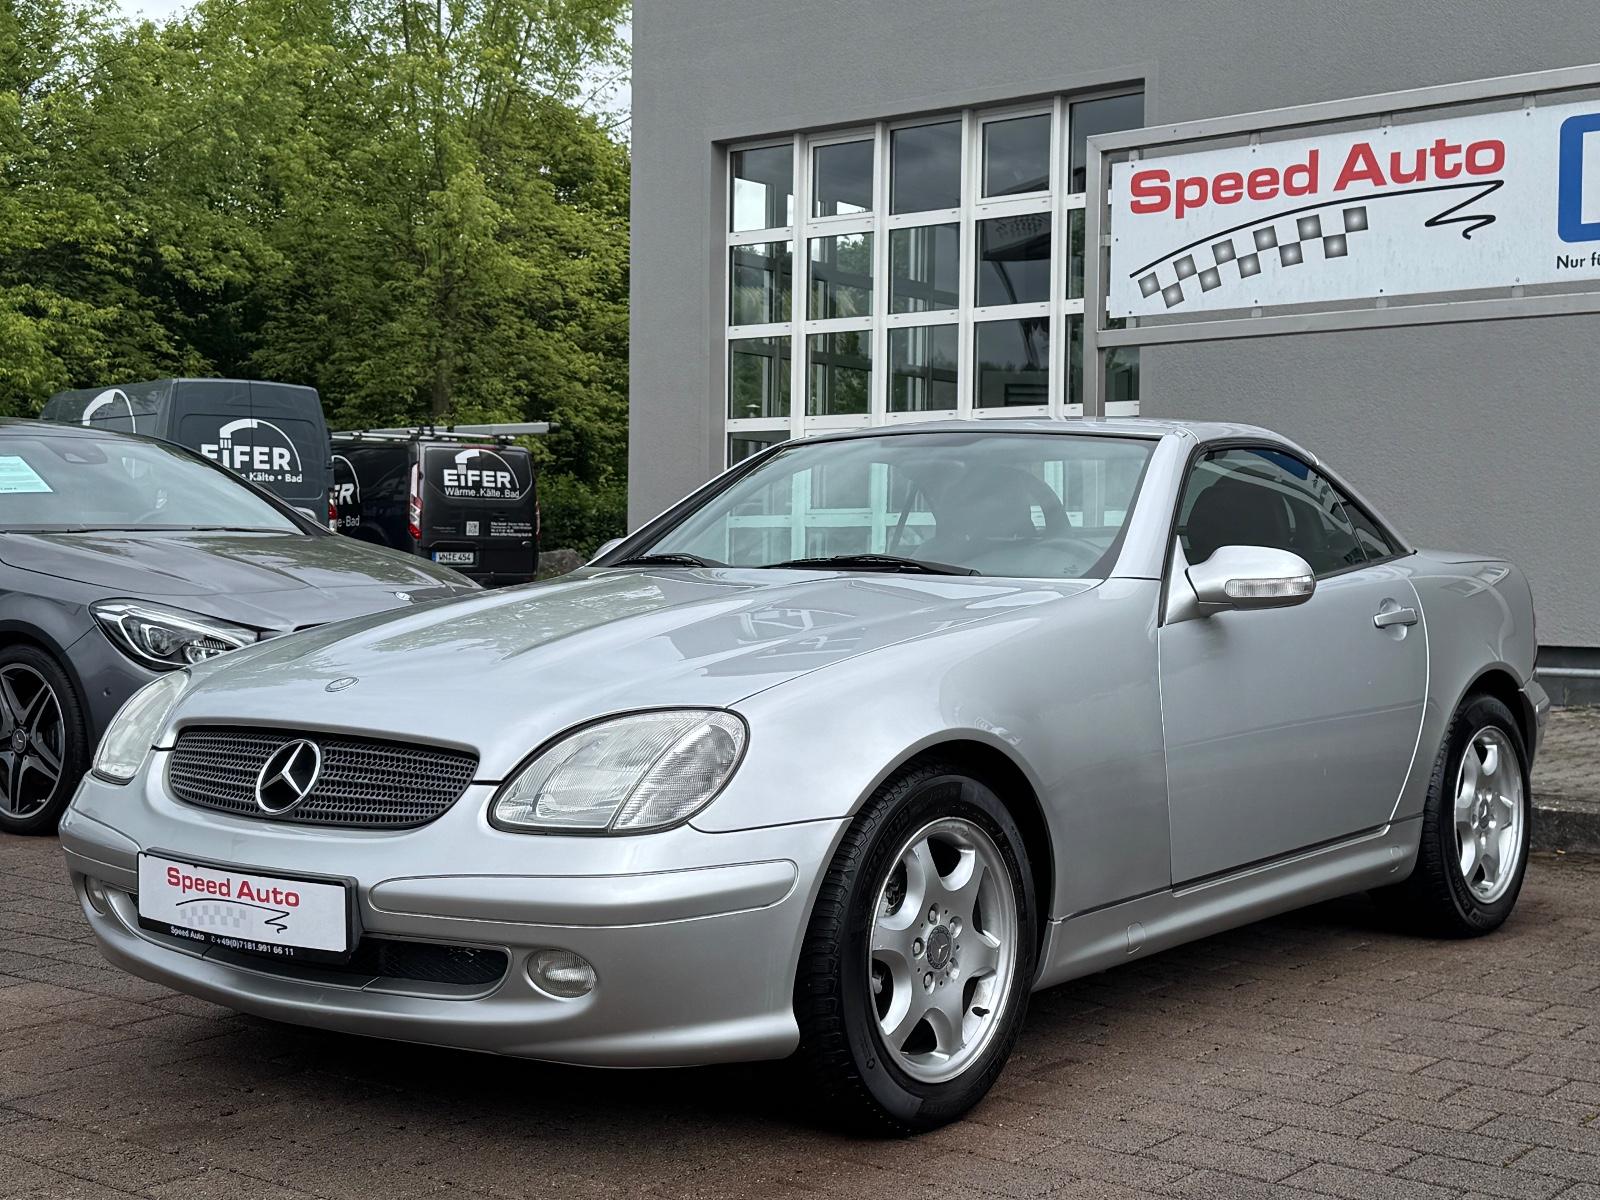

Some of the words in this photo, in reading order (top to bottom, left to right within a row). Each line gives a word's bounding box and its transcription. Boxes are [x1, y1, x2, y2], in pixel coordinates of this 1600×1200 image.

[1129, 149, 1319, 219] Speed
[1332, 138, 1506, 191] Auto
[1556, 255, 1586, 269] Nur
[249, 471, 275, 482] Kälte
[285, 473, 303, 483] Bad
[346, 515, 360, 527] Bad
[167, 866, 231, 897] Speed
[236, 880, 300, 907] Auto
[170, 925, 189, 938] Speed
[189, 930, 205, 941] Auto
